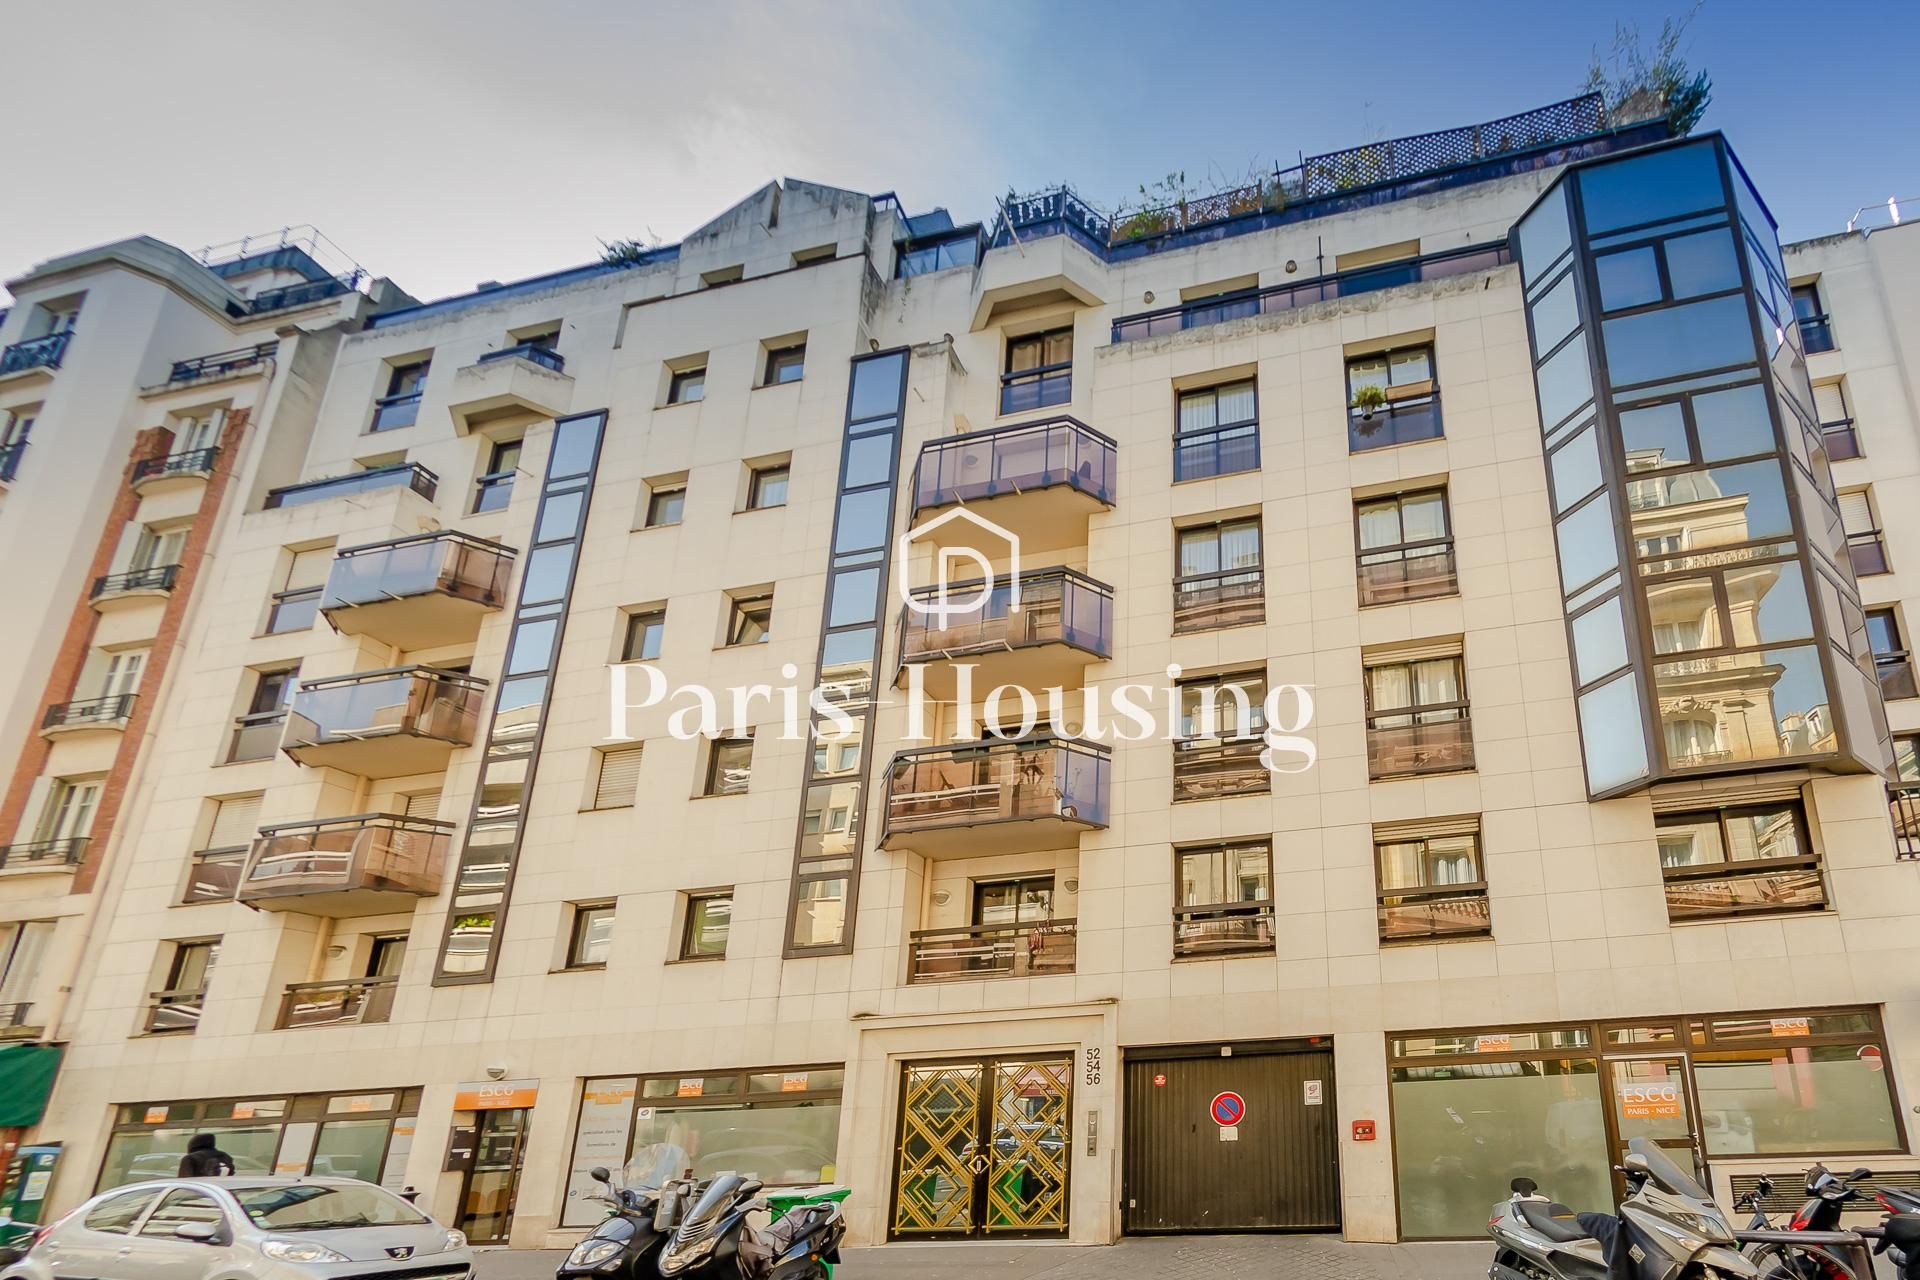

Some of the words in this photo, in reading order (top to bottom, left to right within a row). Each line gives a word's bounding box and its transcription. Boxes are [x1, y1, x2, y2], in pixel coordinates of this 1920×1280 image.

[1773, 1018, 1808, 1029] ESCG
[1086, 1048, 1101, 1060] 52
[1086, 1060, 1101, 1073] 54
[1086, 1073, 1101, 1086] 56
[1623, 1086, 1677, 1103] ESCG
